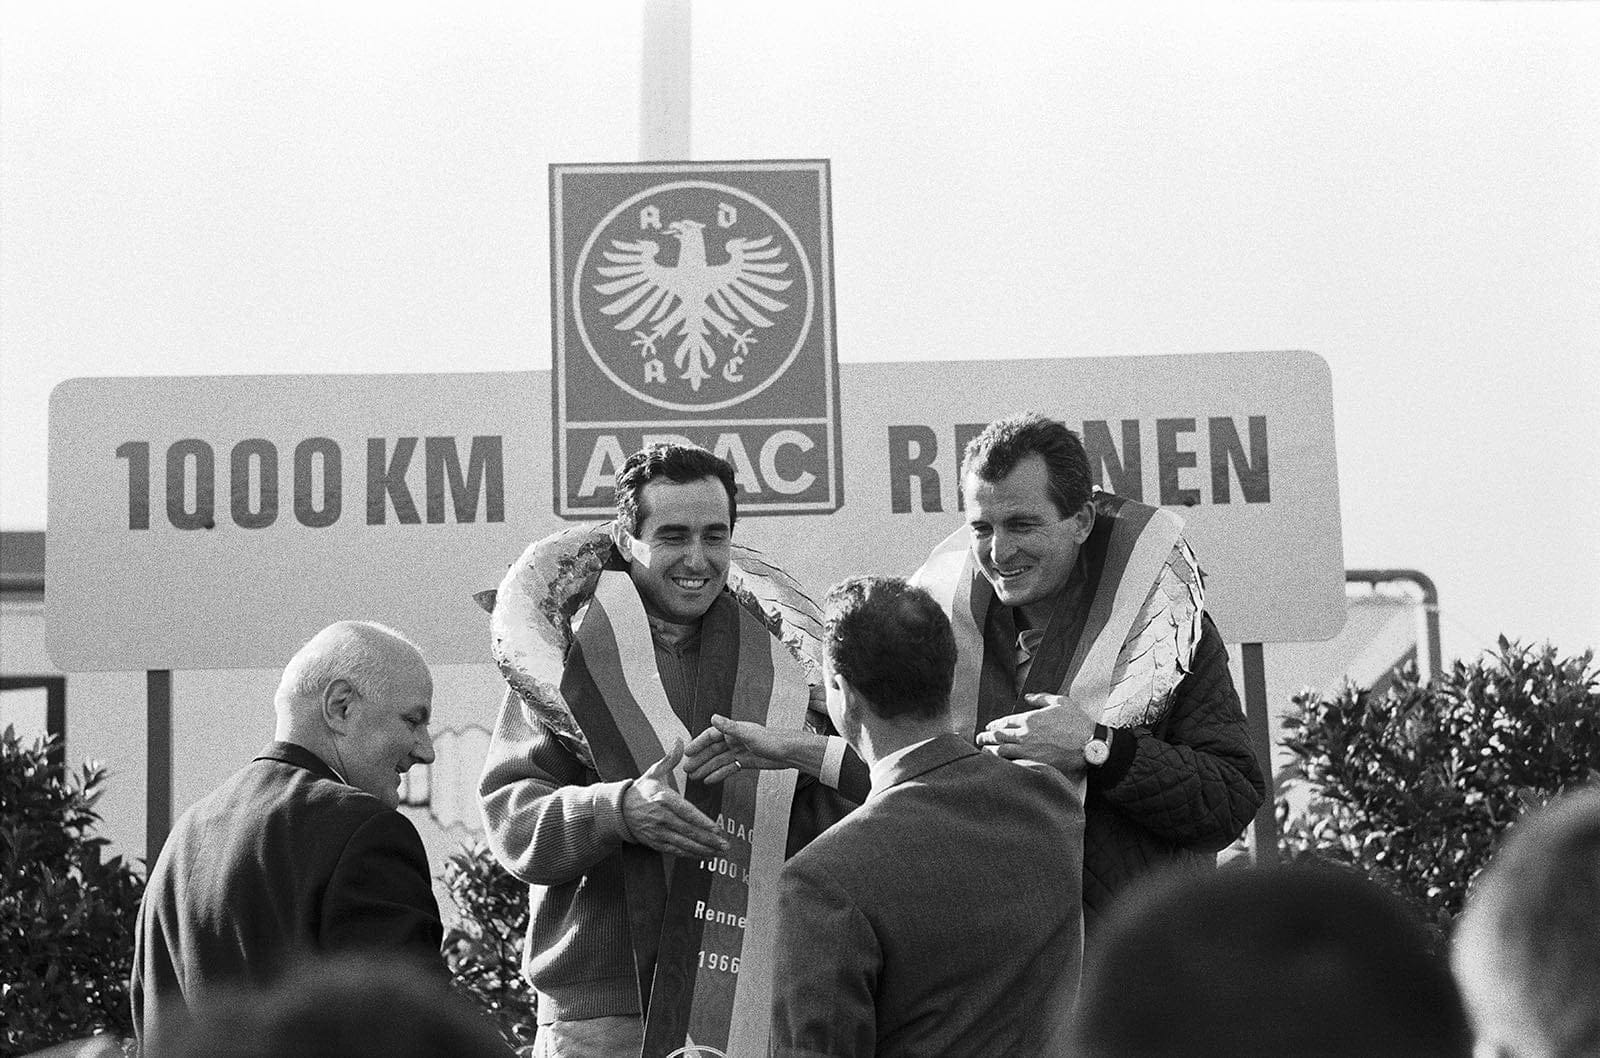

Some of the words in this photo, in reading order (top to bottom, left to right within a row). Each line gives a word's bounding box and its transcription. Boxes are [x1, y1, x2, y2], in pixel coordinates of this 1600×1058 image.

[115, 437, 343, 531] 1000
[366, 435, 506, 526] KM
[577, 430, 817, 497] AAC
[888, 415, 1271, 514] RNEN
[698, 951, 740, 973] 1966
